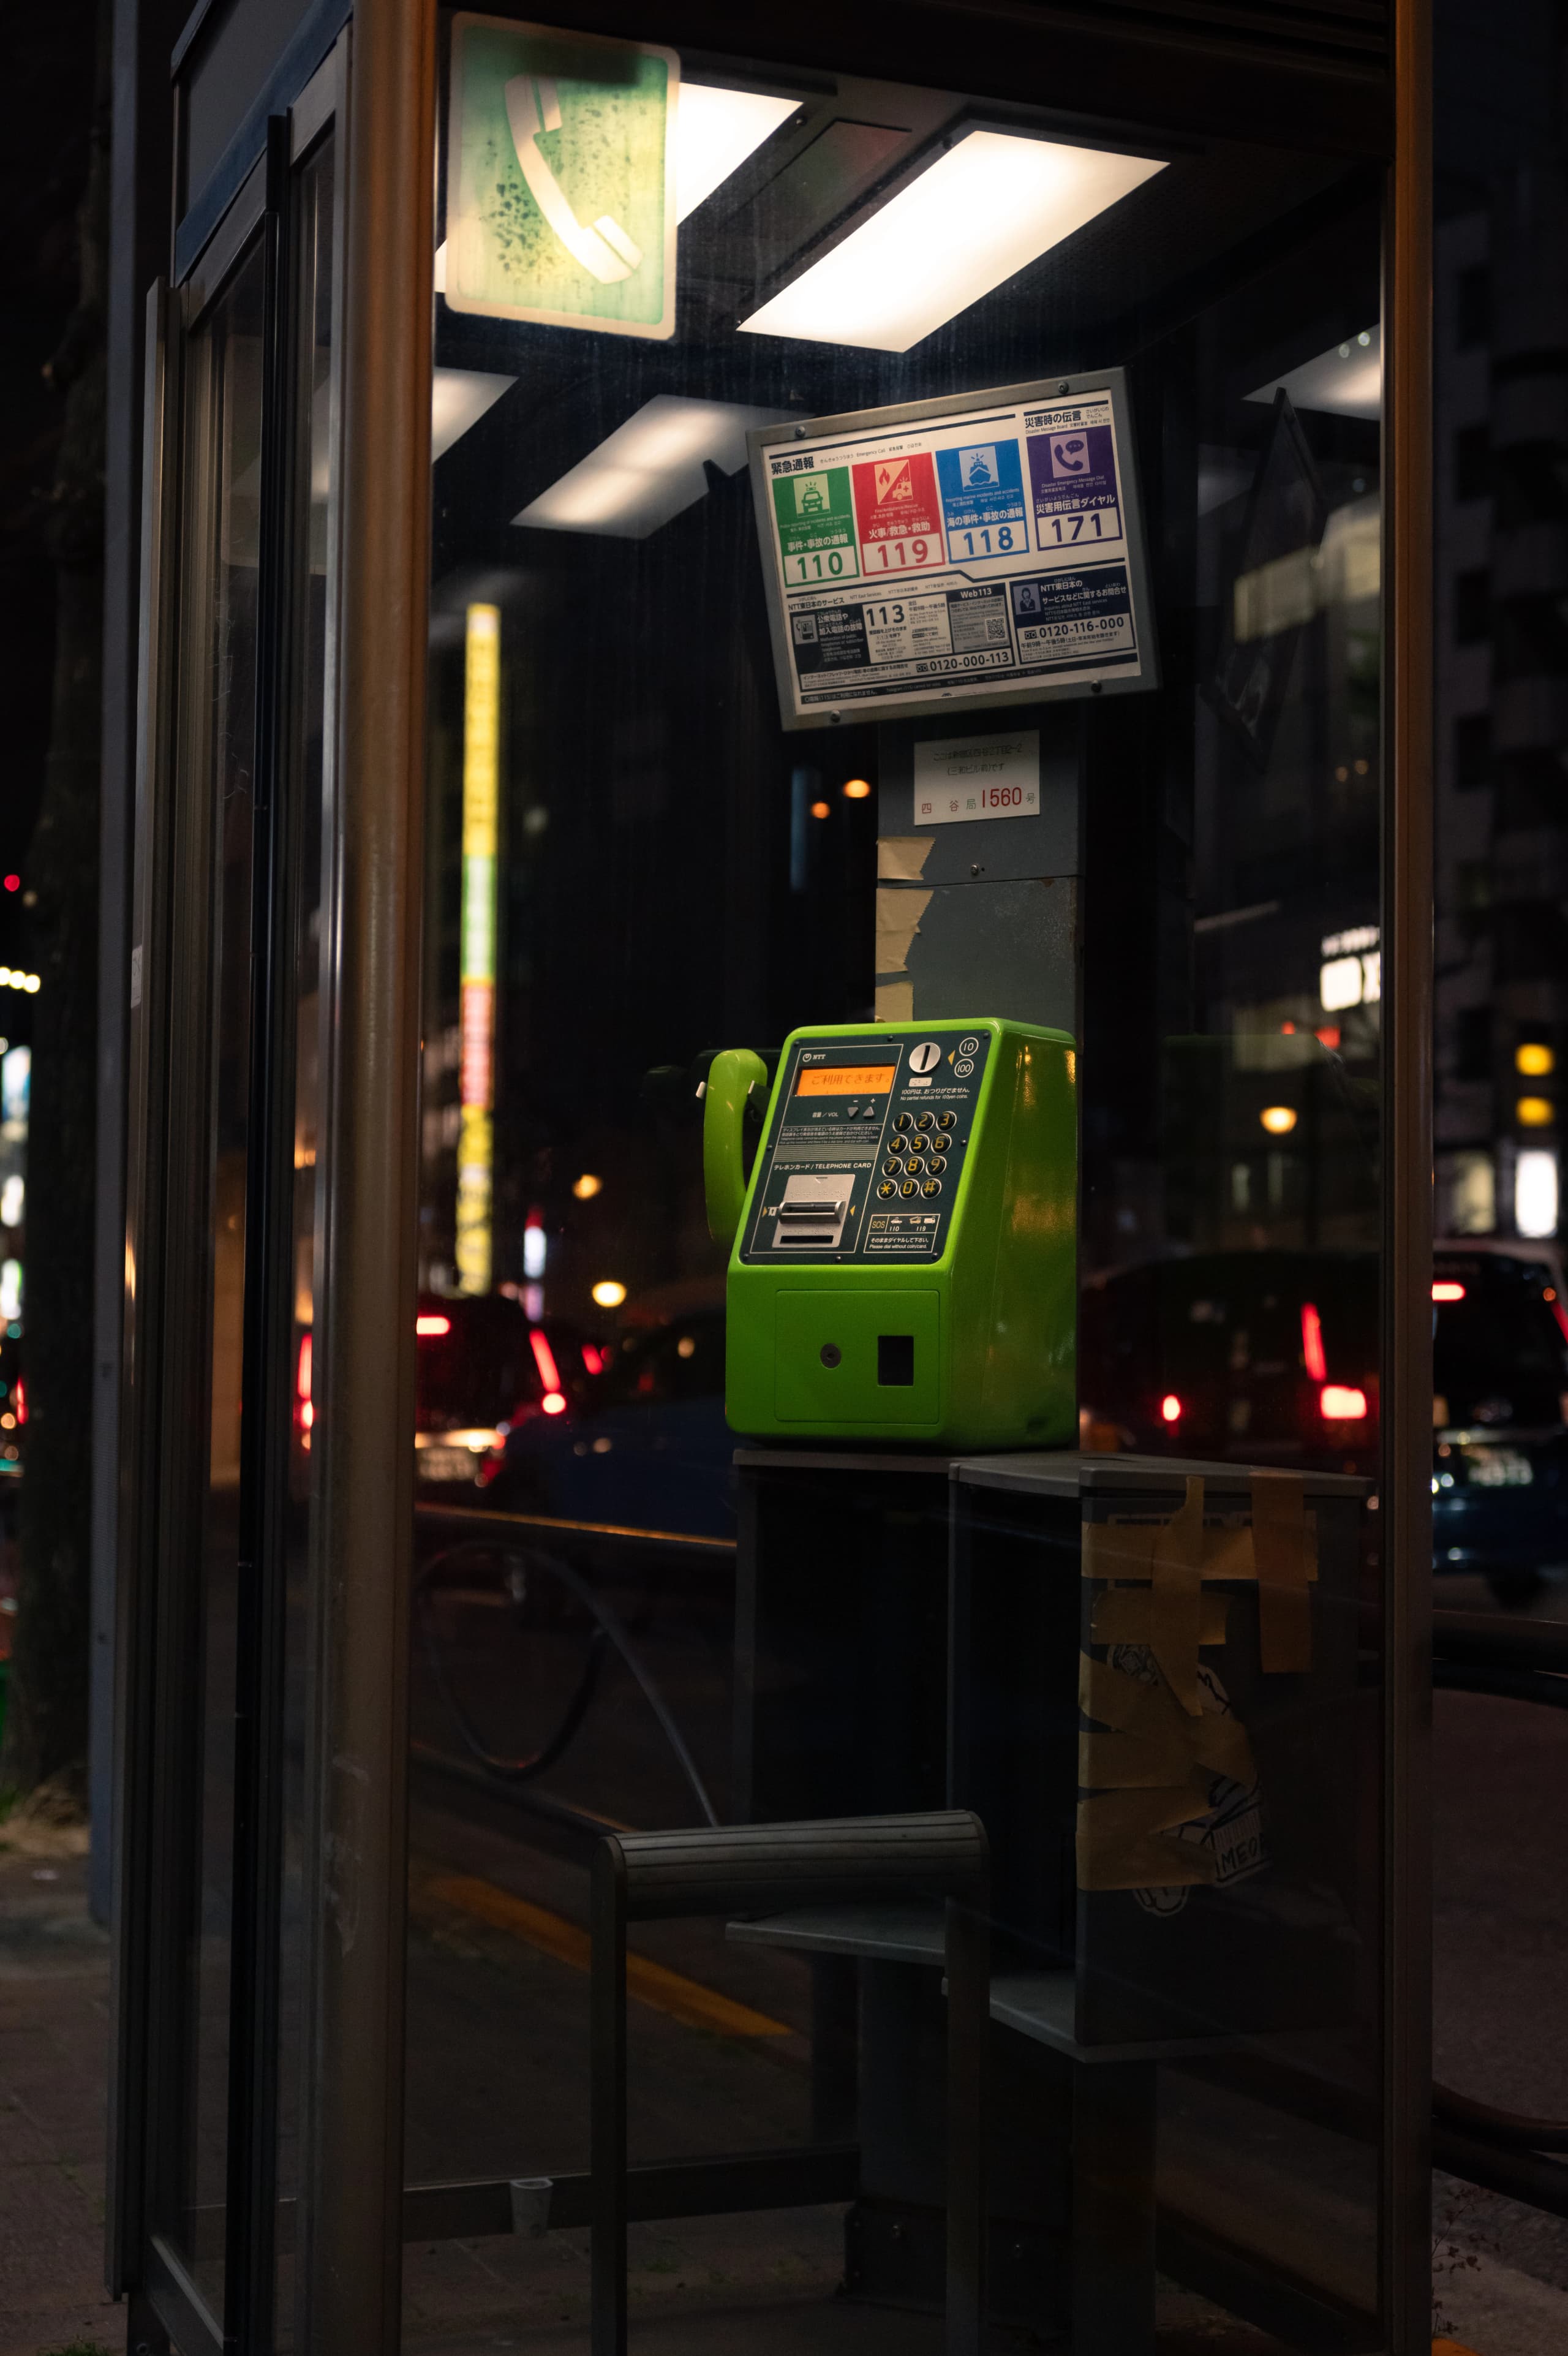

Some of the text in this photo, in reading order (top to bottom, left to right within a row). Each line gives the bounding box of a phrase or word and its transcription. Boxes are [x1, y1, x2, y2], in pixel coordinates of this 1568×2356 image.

[1025, 410, 1081, 428] 災害時の伝言
[771, 457, 815, 475] 緊急通報
[1036, 494, 1116, 515] 災害用伝言ダイヤル
[947, 507, 1023, 527] 海の事件・事故の通報
[1052, 513, 1101, 542] 171
[787, 533, 848, 552] 事件・事故の通報
[963, 526, 1014, 556] 118
[878, 539, 928, 568] 119
[797, 551, 843, 580] 110
[960, 587, 992, 598] Web113
[1041, 580, 1083, 593] NTT東日本の
[1042, 586, 1127, 605] サービスなどに関するお問合せ
[788, 597, 845, 611] NTT東日本のサービス
[866, 604, 905, 626] 113
[1039, 617, 1124, 638] 0120-116-000
[930, 651, 1009, 671] 0120-000-113
[982, 787, 1022, 808] 1560
[1025, 792, 1036, 804] 号
[963, 1043, 974, 1051] 10
[957, 1064, 971, 1073] 100
[812, 1073, 890, 1085] ご利用できます。
[899, 1113, 949, 1127] 1 2 3
[891, 1136, 945, 1150] 4 5 6
[888, 1158, 941, 1172] 7 8 9
[903, 1181, 914, 1194] 0
[872, 1220, 886, 1229] SOS
